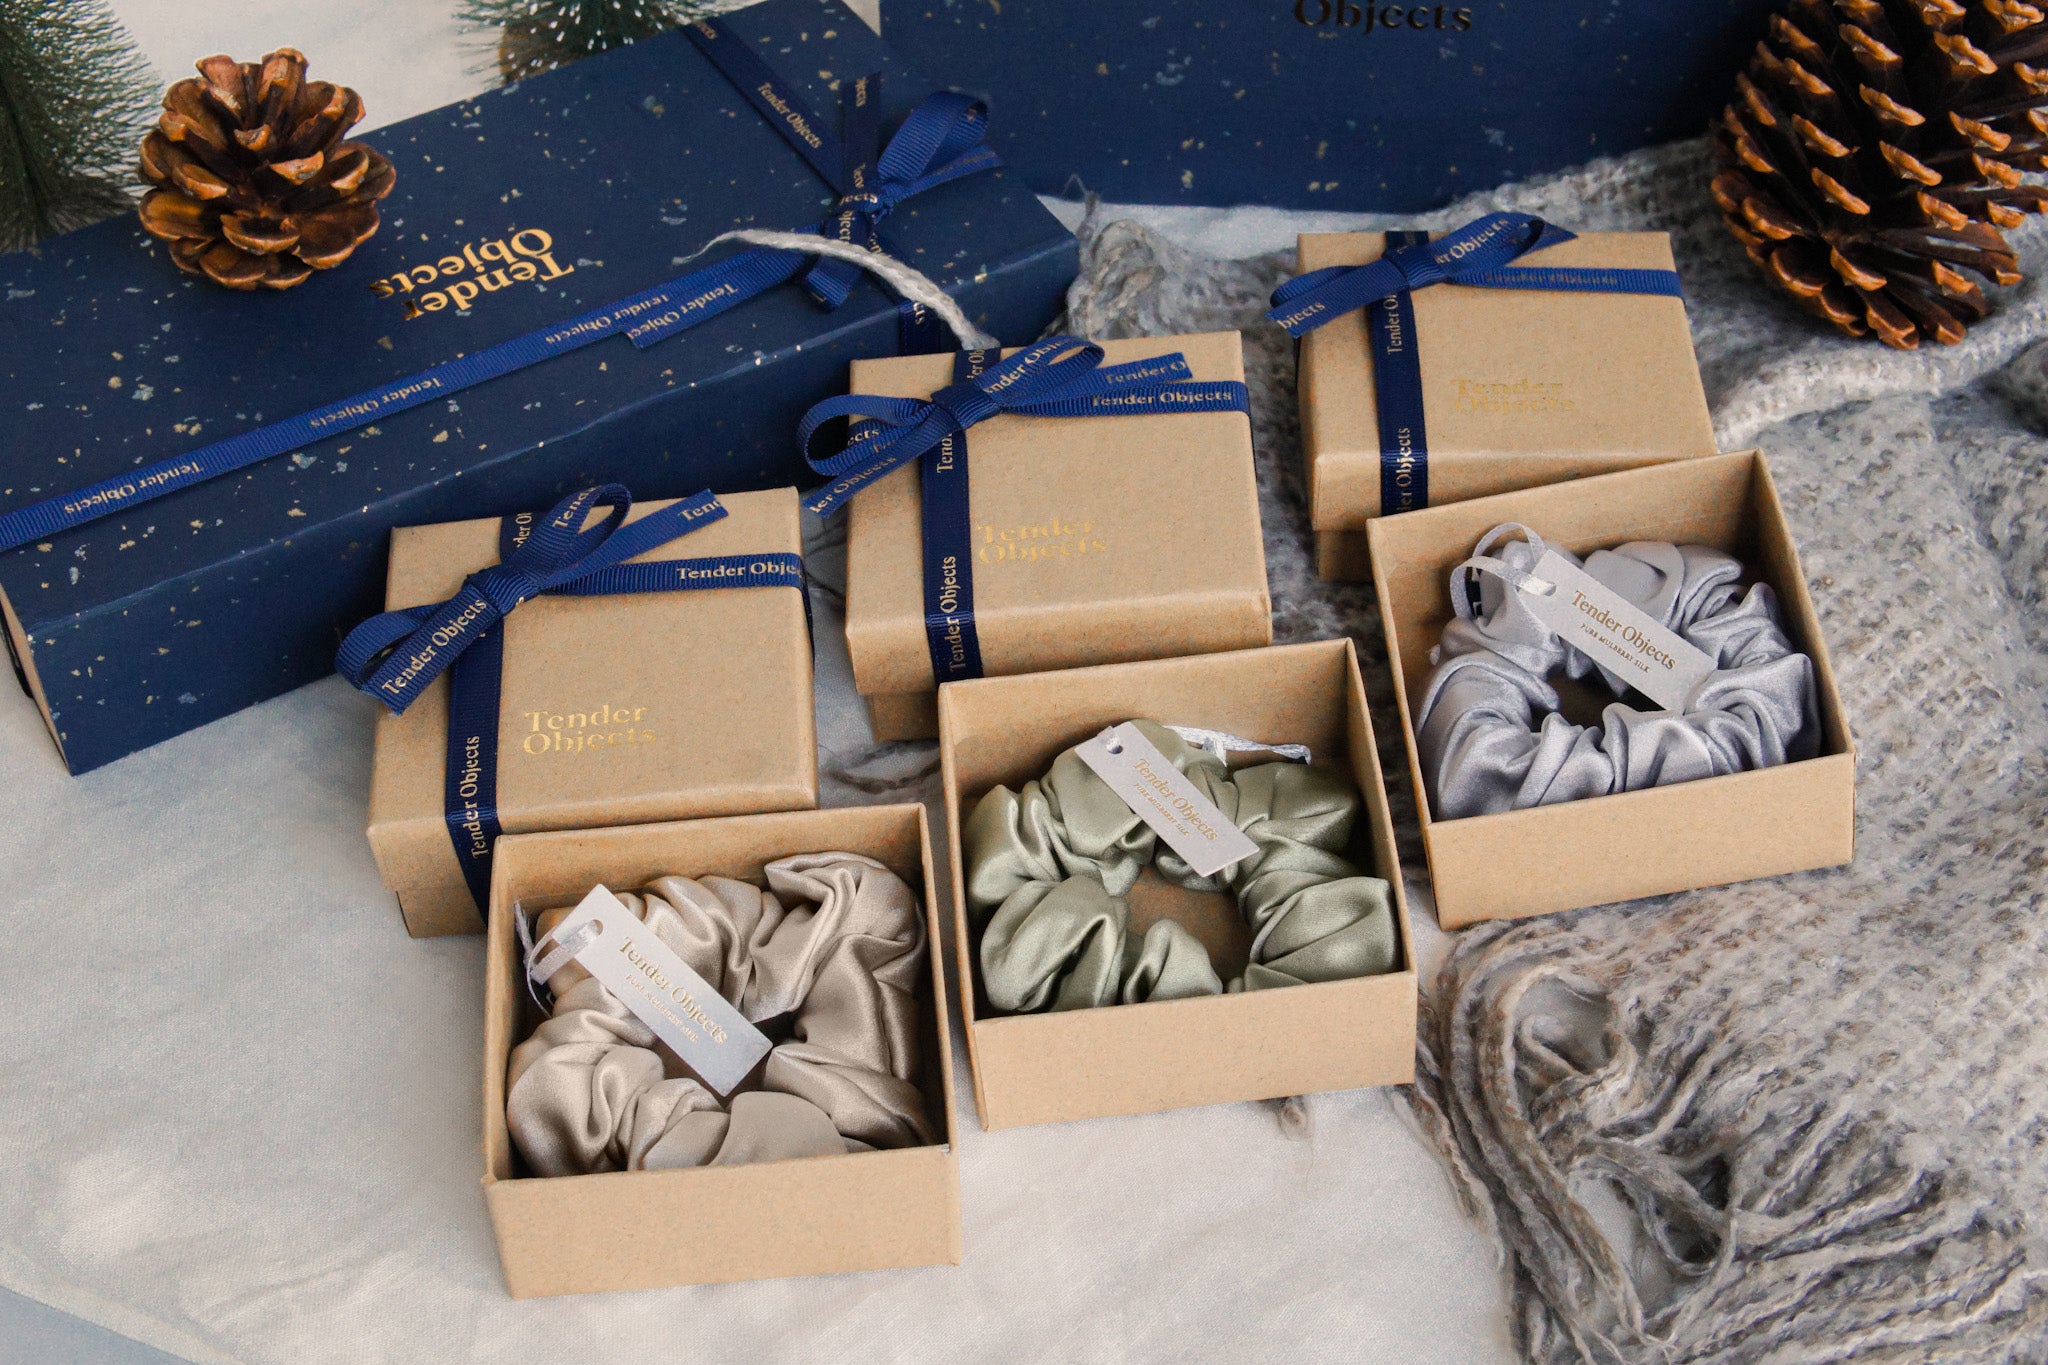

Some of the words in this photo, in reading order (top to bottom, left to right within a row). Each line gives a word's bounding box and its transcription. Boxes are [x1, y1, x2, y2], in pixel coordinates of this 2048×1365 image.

[1294, 0, 1472, 35] Objects
[758, 82, 790, 114] Tender
[786, 112, 822, 149] Objects
[369, 228, 553, 299] Objects
[402, 252, 575, 321] Tender
[681, 283, 738, 314] Tender
[546, 316, 612, 344] Objects
[1386, 312, 1402, 355] Tender
[382, 378, 444, 404] Tender
[1092, 394, 1155, 407] Tender
[1160, 391, 1232, 404] Objects
[310, 400, 380, 427] Objects
[1395, 427, 1416, 487] Objects
[139, 461, 204, 489] Tender
[64, 485, 136, 514] Objects
[977, 517, 1096, 544] Tender
[978, 538, 1108, 564] Objects
[676, 565, 745, 580] Tender
[939, 555, 961, 614] Objects
[381, 644, 437, 695] Tender
[431, 599, 487, 648] Objects
[944, 616, 967, 673] Tender
[1572, 590, 1624, 634] Tender
[1621, 625, 1676, 670] Objects
[1598, 635, 1634, 662] MULBERRY
[525, 704, 647, 733] Tender
[523, 728, 657, 755] Objects
[460, 735, 482, 798] Objects
[1132, 758, 1176, 799] Tender
[1172, 797, 1218, 841] Objects
[462, 802, 488, 859] Tender
[619, 936, 674, 991] Tender
[671, 985, 728, 1044] Objects
